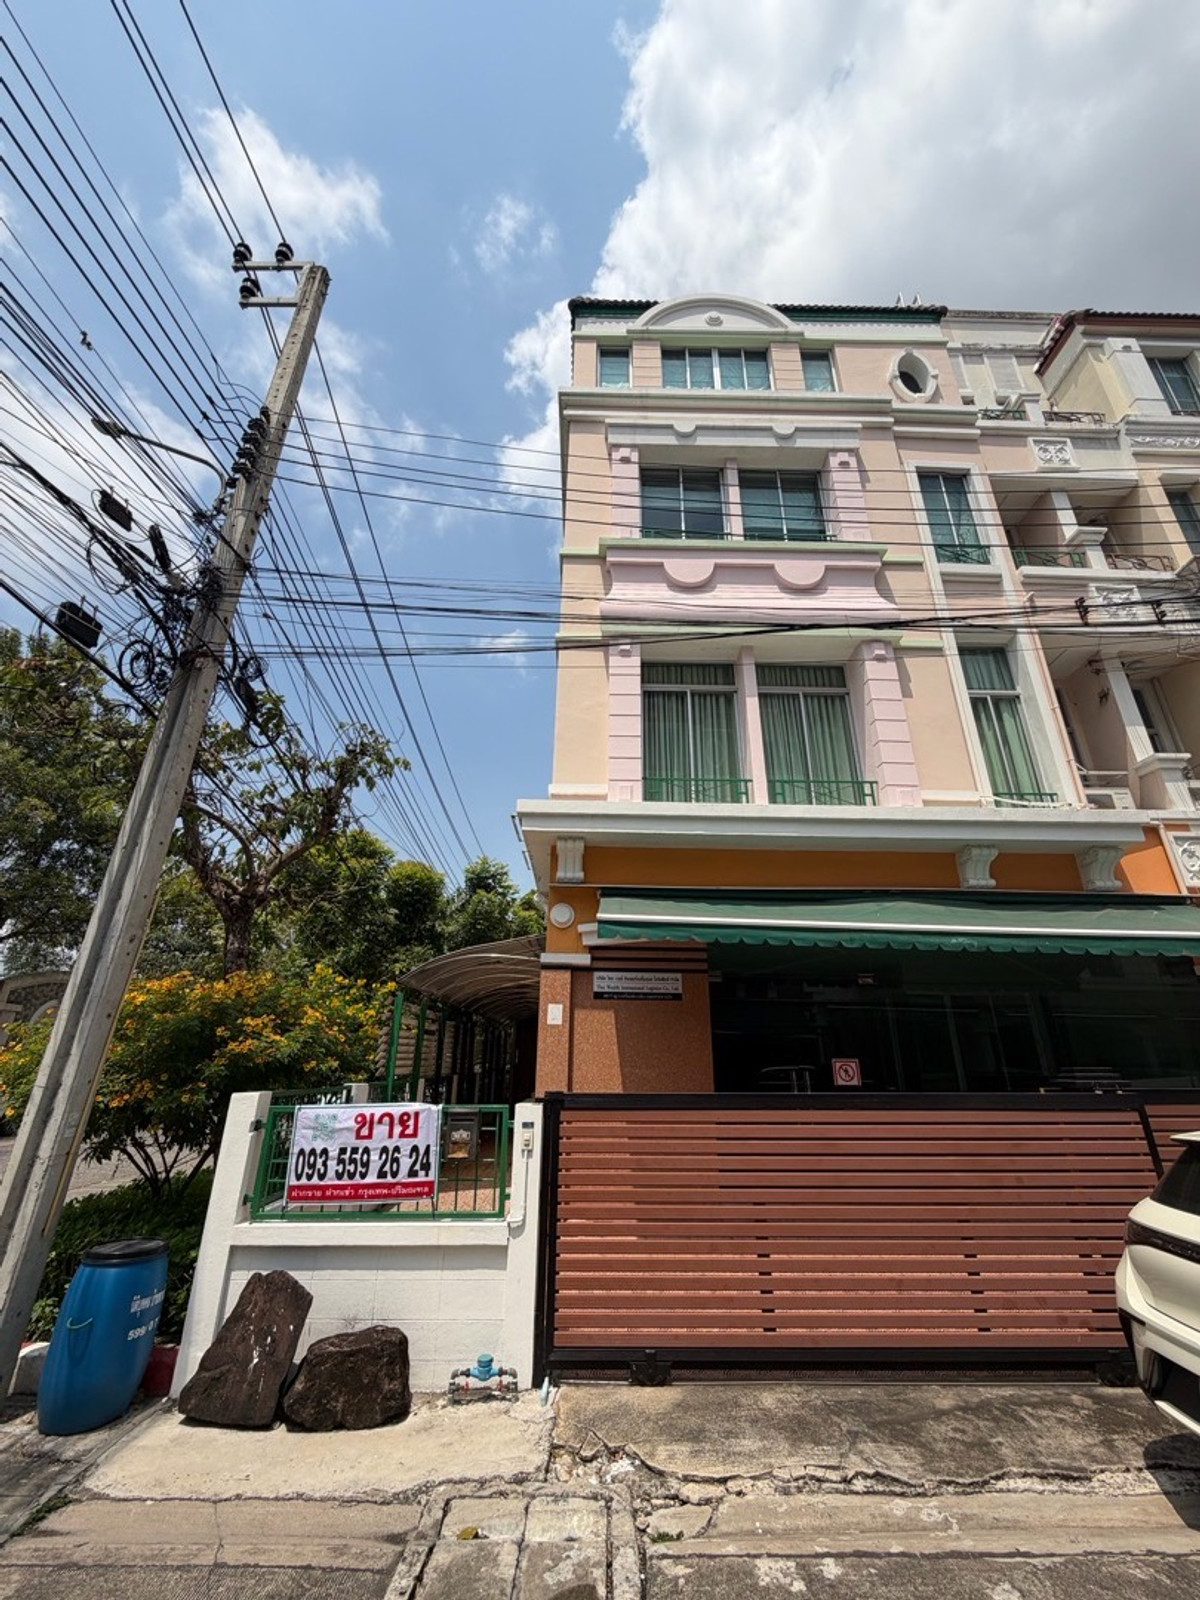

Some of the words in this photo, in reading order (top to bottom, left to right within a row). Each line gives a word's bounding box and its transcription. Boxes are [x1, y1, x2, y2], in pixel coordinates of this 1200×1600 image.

[354, 1110, 420, 1141] ขาย
[294, 1146, 330, 1182] 093
[334, 1145, 370, 1181] 559
[376, 1144, 402, 1180] 26
[407, 1143, 432, 1178] 24
[291, 1189, 322, 1198] ฝากขาย
